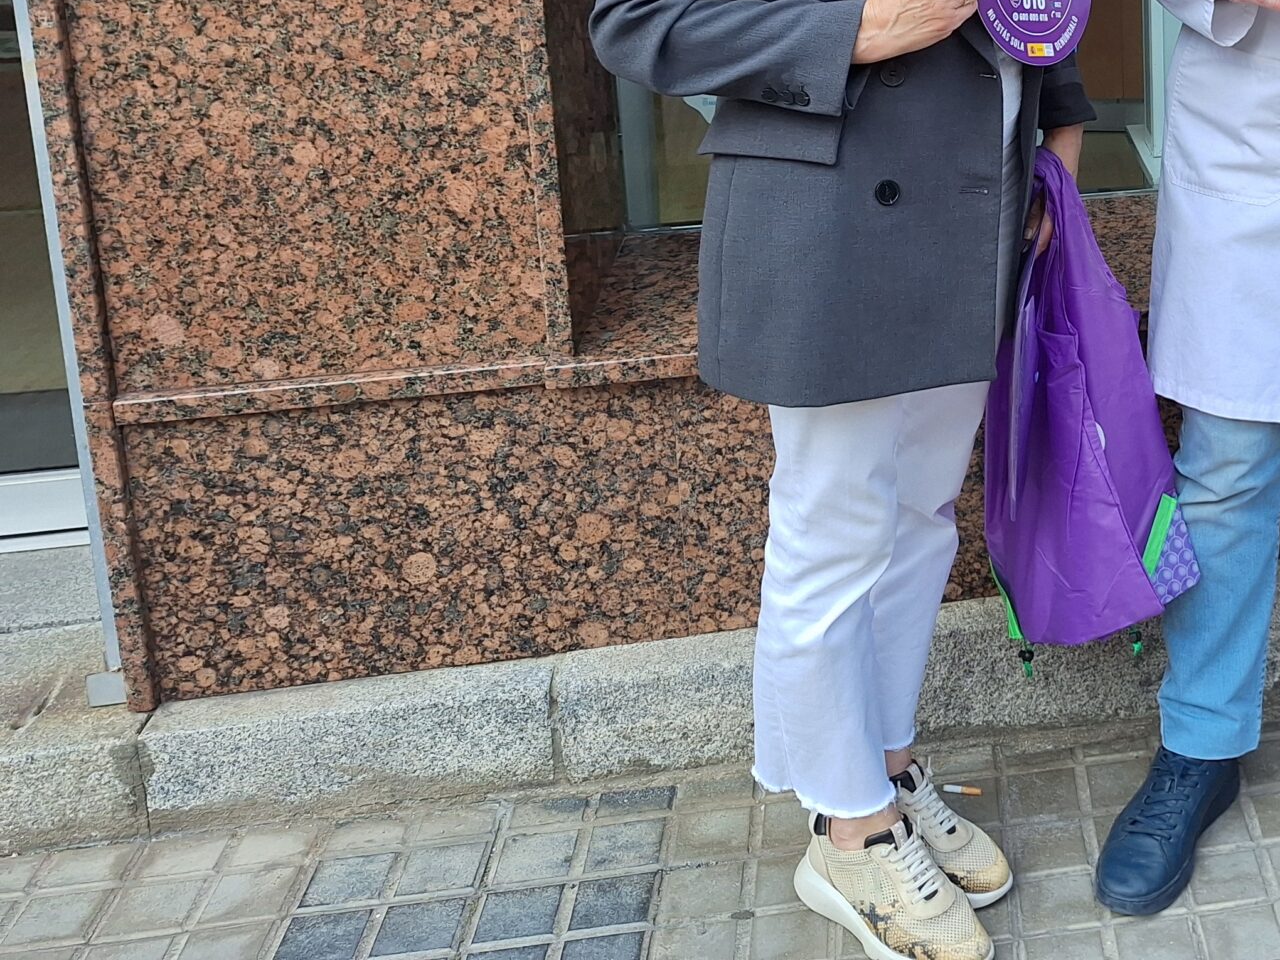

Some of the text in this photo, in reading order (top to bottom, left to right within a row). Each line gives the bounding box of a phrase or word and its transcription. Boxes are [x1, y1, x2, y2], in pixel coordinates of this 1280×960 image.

[987, 8, 1024, 52] NO ESTÁS SOLA
